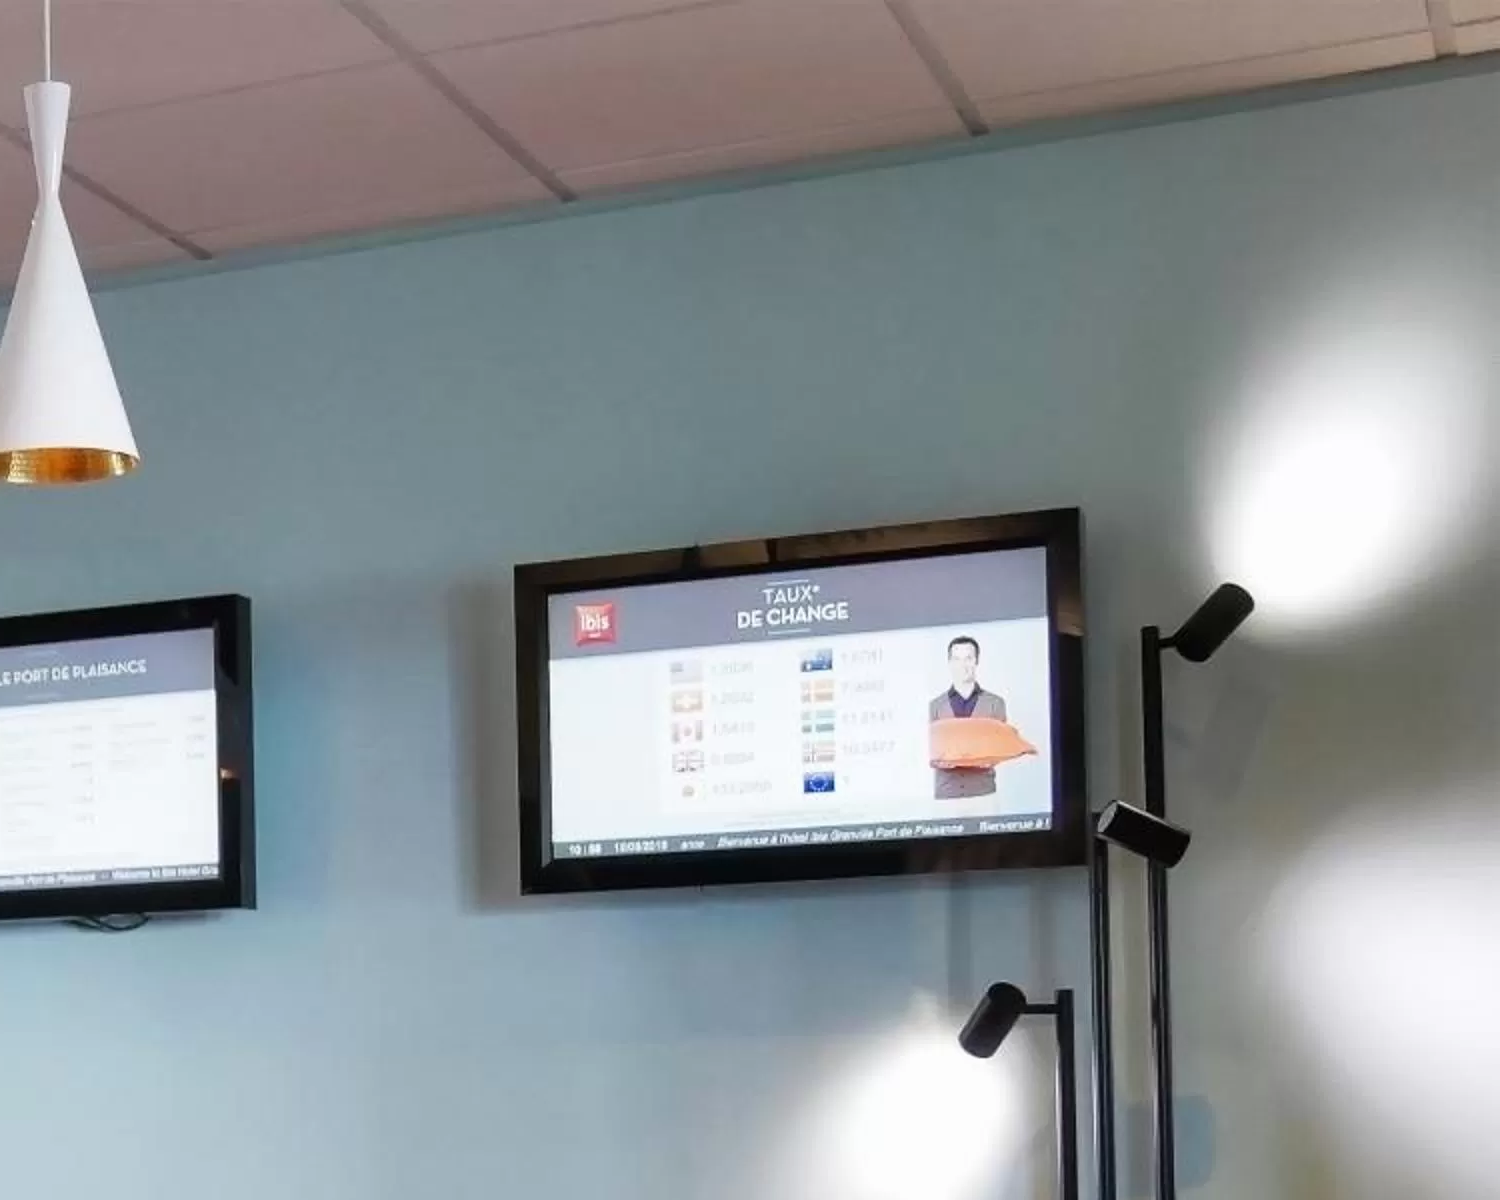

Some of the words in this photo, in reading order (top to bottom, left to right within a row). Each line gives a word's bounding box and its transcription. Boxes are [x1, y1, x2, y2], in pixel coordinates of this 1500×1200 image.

[737, 610, 763, 629] DE
[766, 602, 849, 625] CHANGE
[13, 667, 50, 685] PORT
[52, 666, 70, 681] DE
[72, 659, 147, 679] PLAISANCE
